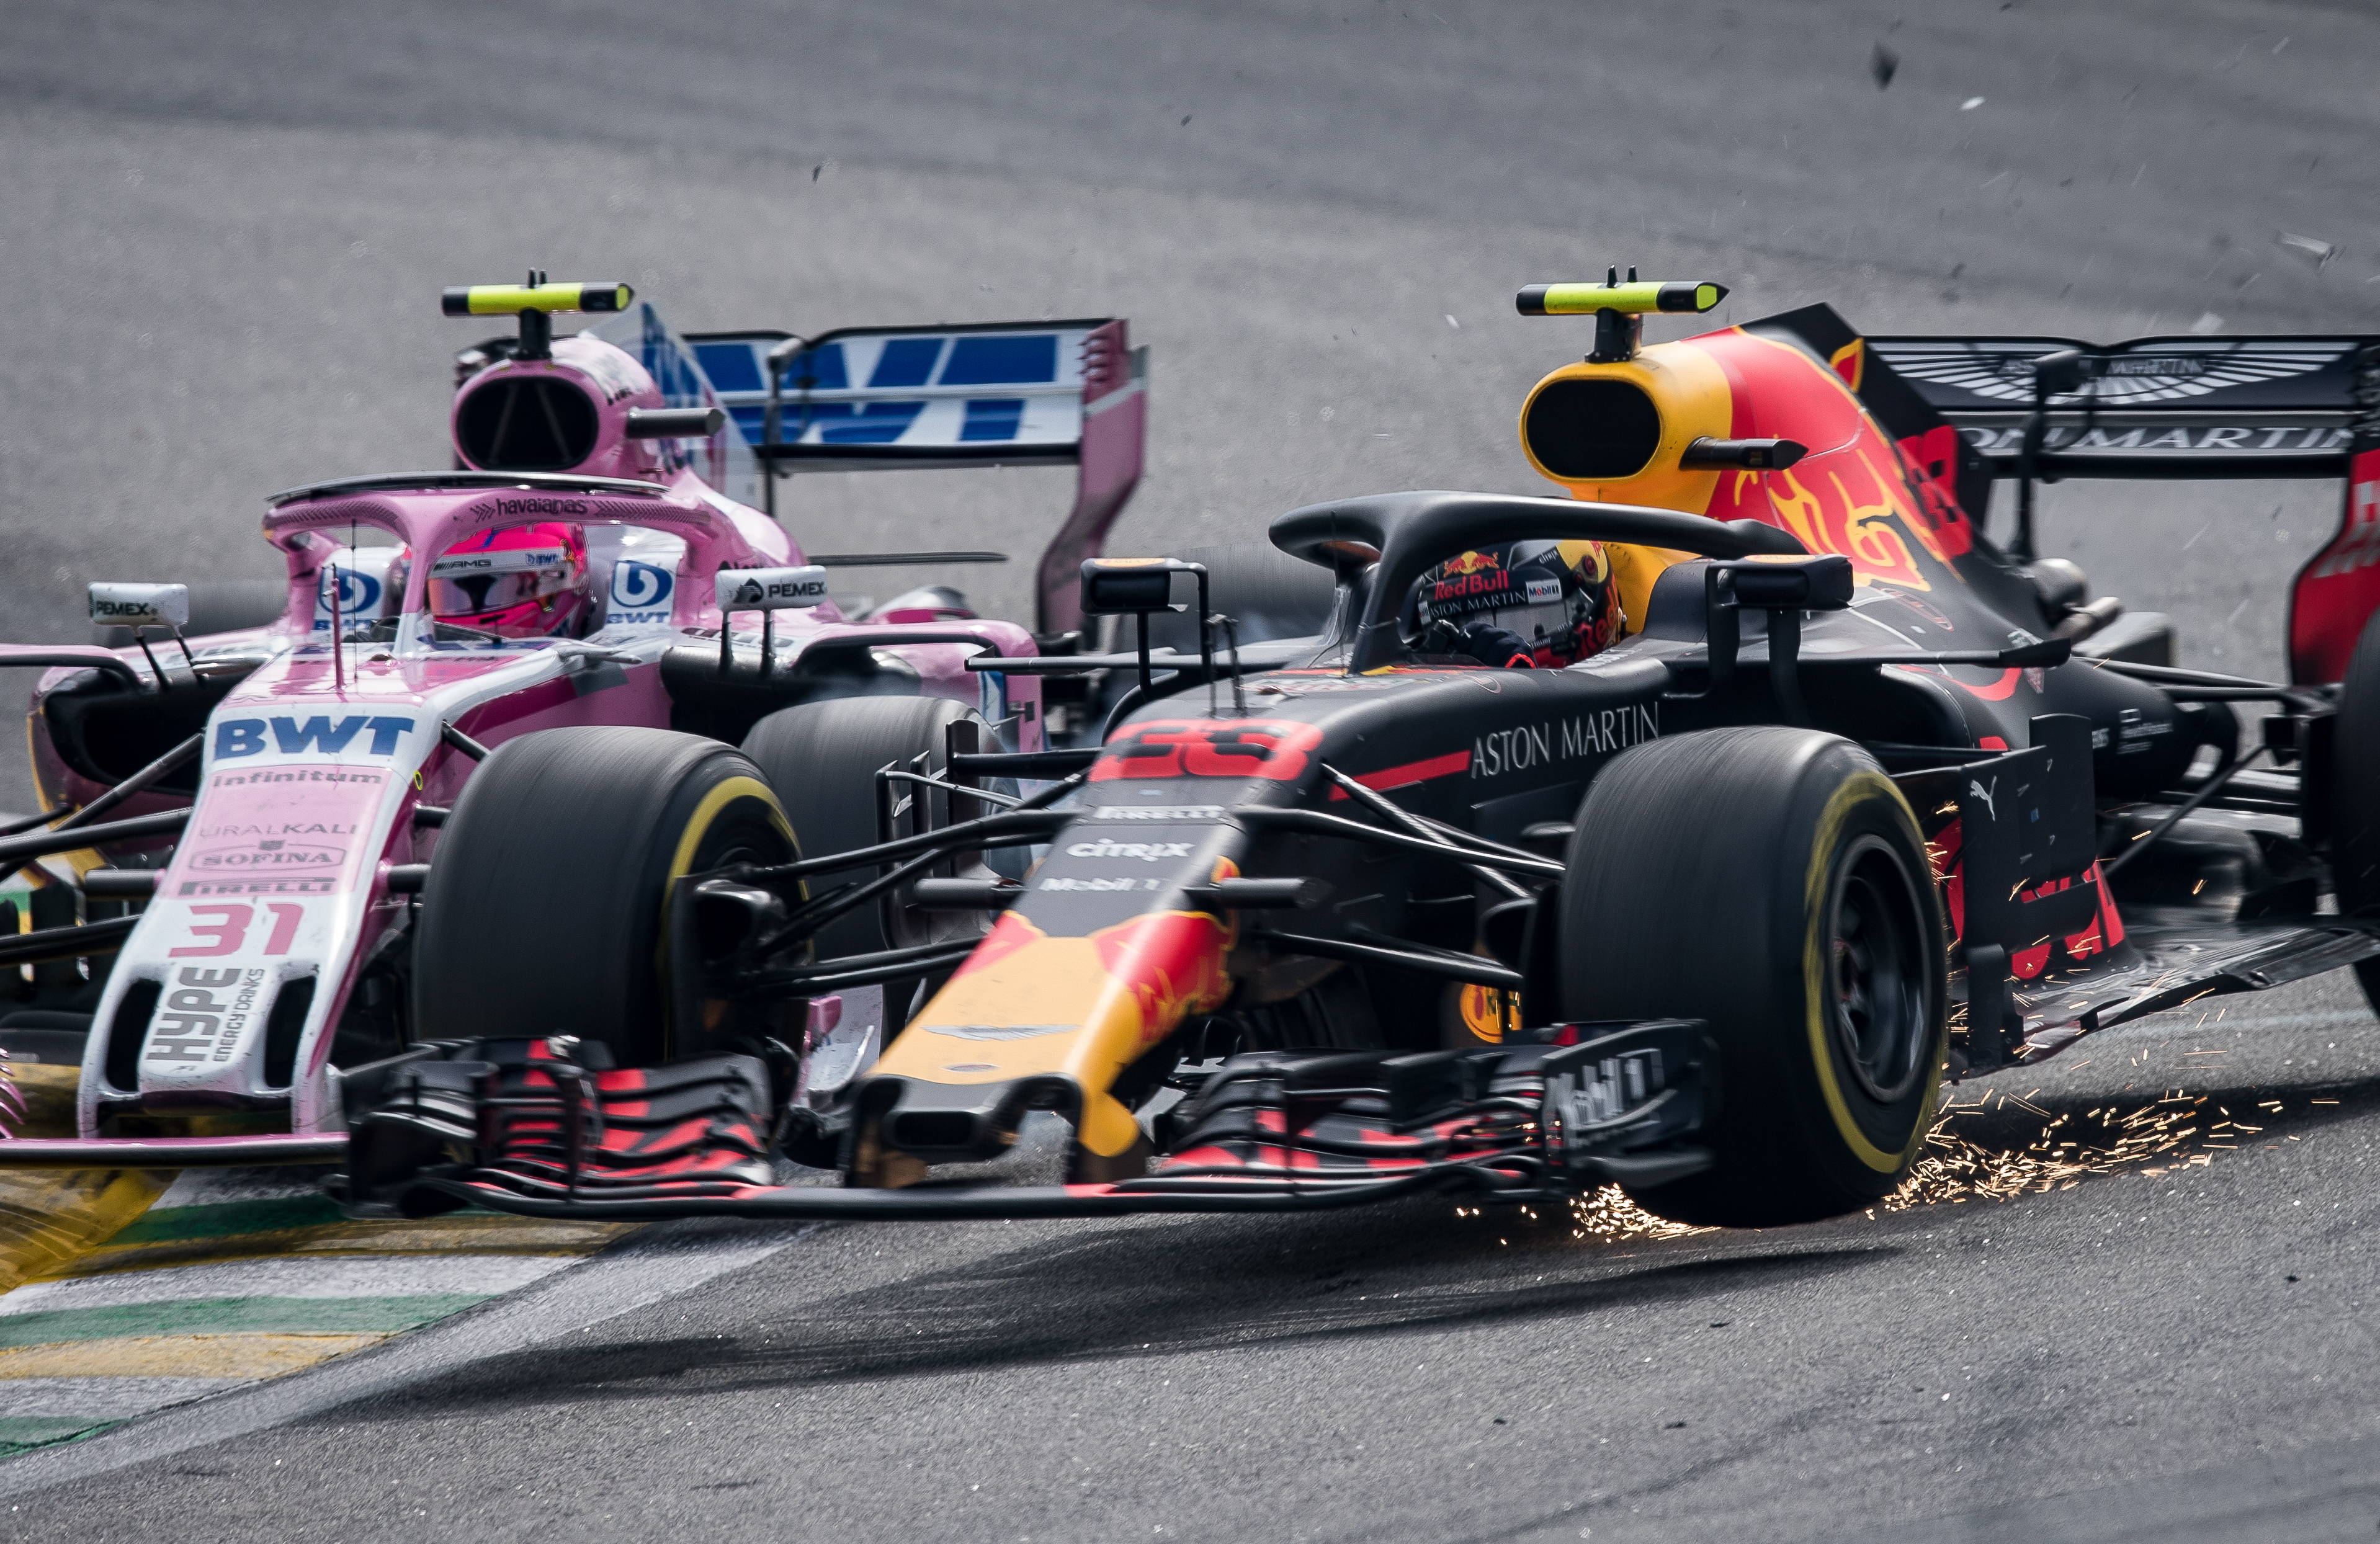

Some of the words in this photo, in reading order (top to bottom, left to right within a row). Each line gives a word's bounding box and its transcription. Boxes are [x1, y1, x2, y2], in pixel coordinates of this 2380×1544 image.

[496, 498, 588, 516] havaianas
[451, 559, 491, 568] AMG
[767, 581, 826, 597] PEMEX
[1435, 576, 1467, 601] Red
[1470, 569, 1509, 594] Bull
[1529, 586, 1553, 597] Mobil
[96, 602, 150, 615] PEMEX
[1429, 599, 1462, 618] ASTON
[1467, 591, 1526, 610] MARTIN
[607, 612, 669, 624] BWT
[213, 715, 415, 761] BWT
[1470, 721, 1550, 779] ASTON
[1561, 700, 1659, 760] MARTIN
[214, 770, 382, 787] infinitum
[199, 823, 357, 837] URALKALI
[203, 852, 333, 867] SOFINA
[179, 877, 338, 896] PIRELLI
[1038, 877, 1137, 891] Mobil
[168, 903, 304, 958] 31
[145, 966, 242, 1062] HYPE
[212, 1013, 246, 1063] ENERGY
[234, 968, 266, 1011] DRINKS
